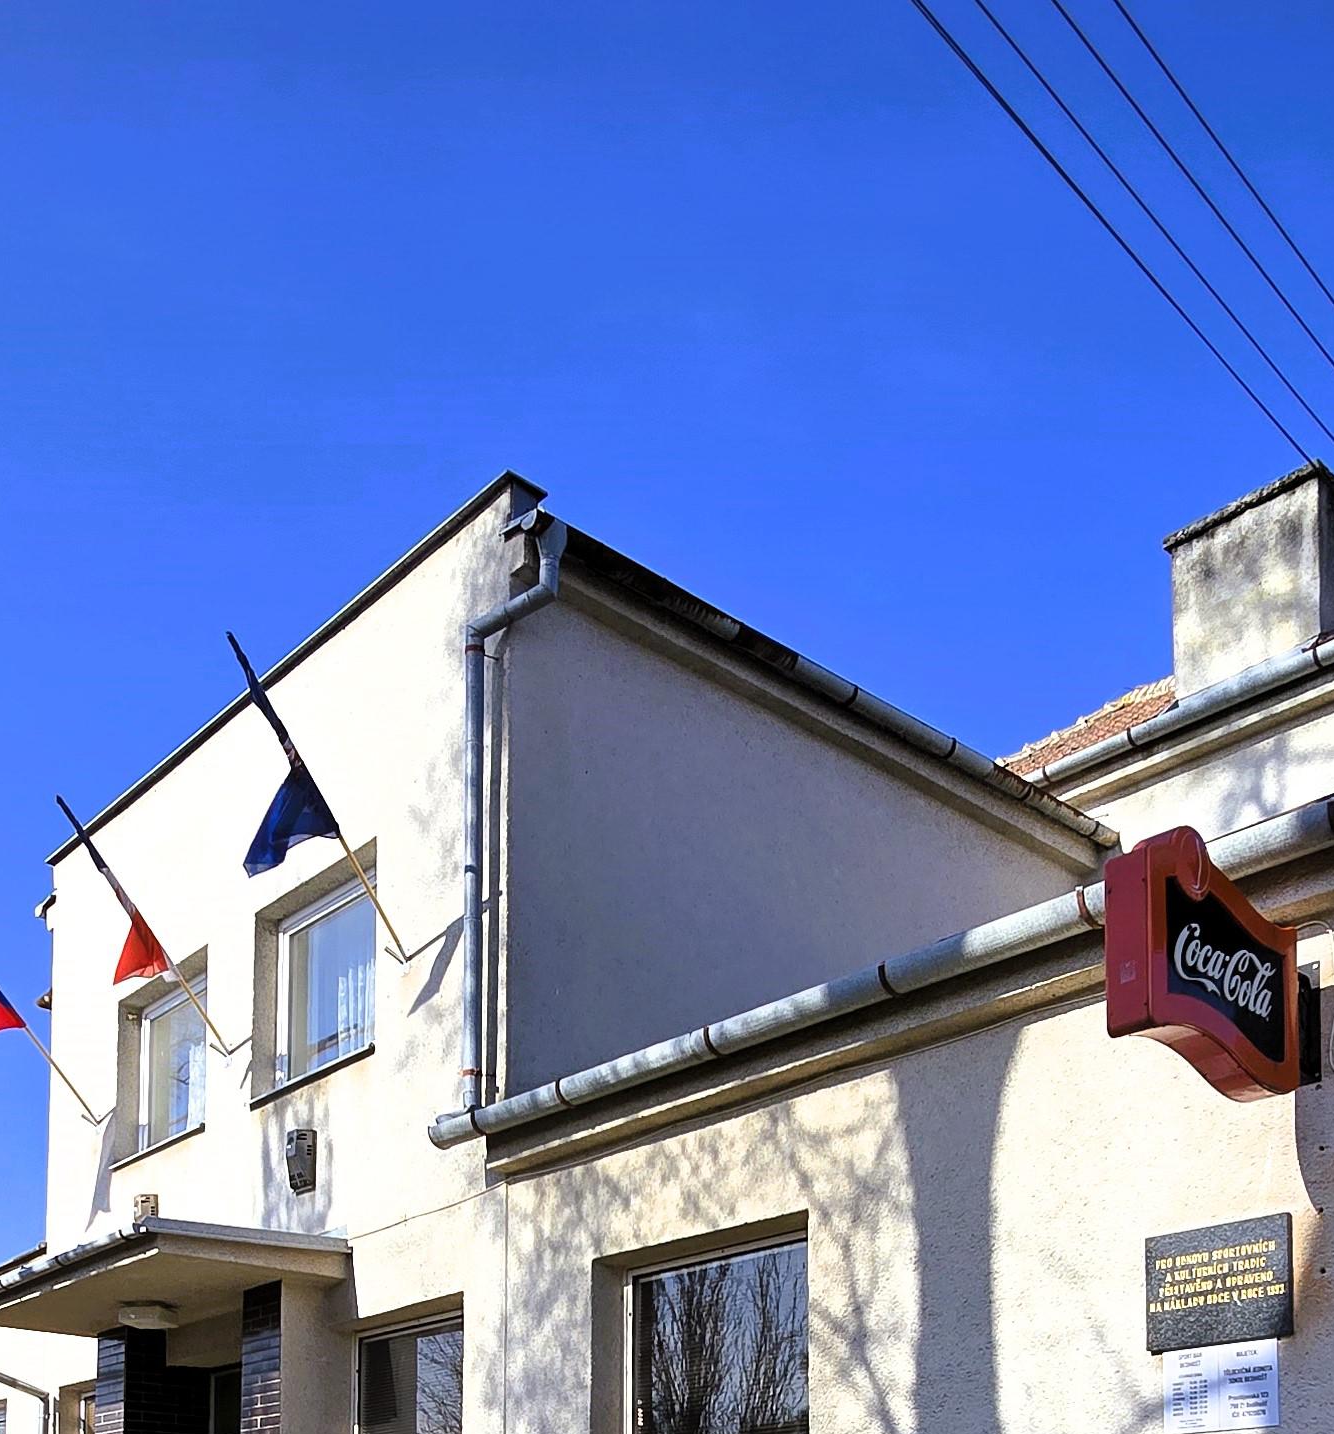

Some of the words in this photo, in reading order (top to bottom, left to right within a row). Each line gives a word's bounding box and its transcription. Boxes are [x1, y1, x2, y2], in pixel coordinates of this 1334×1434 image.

[1174, 923, 1276, 1018] Coca-Cola
[1155, 1257, 1173, 1270] PRO
[1164, 1272, 1172, 1283] A
[1233, 1256, 1267, 1271] TRADIC
[1216, 1278, 1223, 1289] A
[1225, 1270, 1274, 1287] OPRAVENO
[1149, 1302, 1163, 1312] NA
[1240, 1287, 1265, 1300] ROCE
